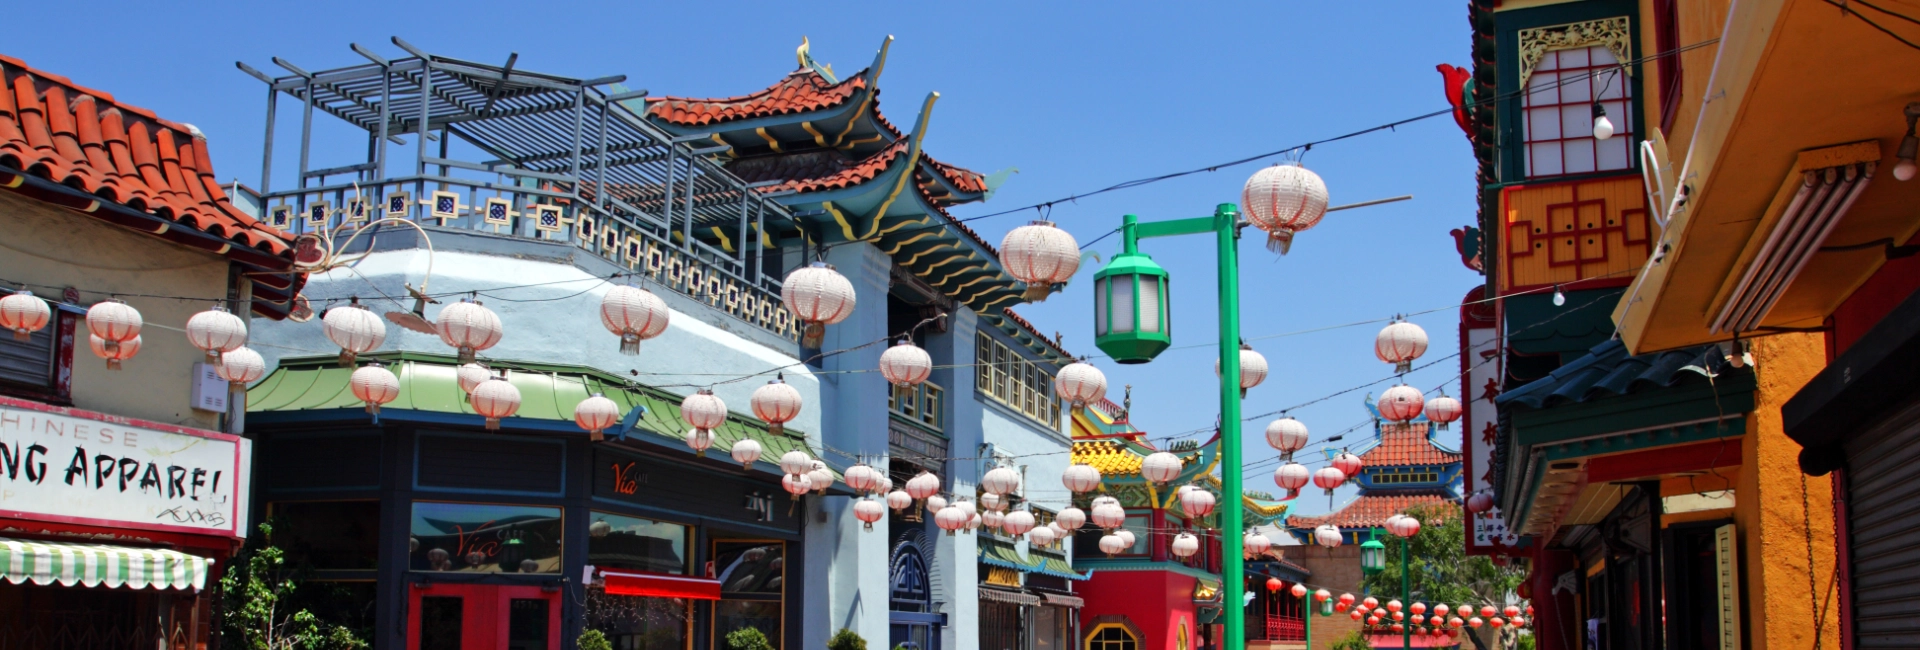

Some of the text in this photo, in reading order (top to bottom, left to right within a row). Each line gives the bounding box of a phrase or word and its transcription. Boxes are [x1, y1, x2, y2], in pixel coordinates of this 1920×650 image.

[1, 411, 138, 448] HINESE
[611, 461, 638, 495] Via
[450, 519, 503, 557] Via
